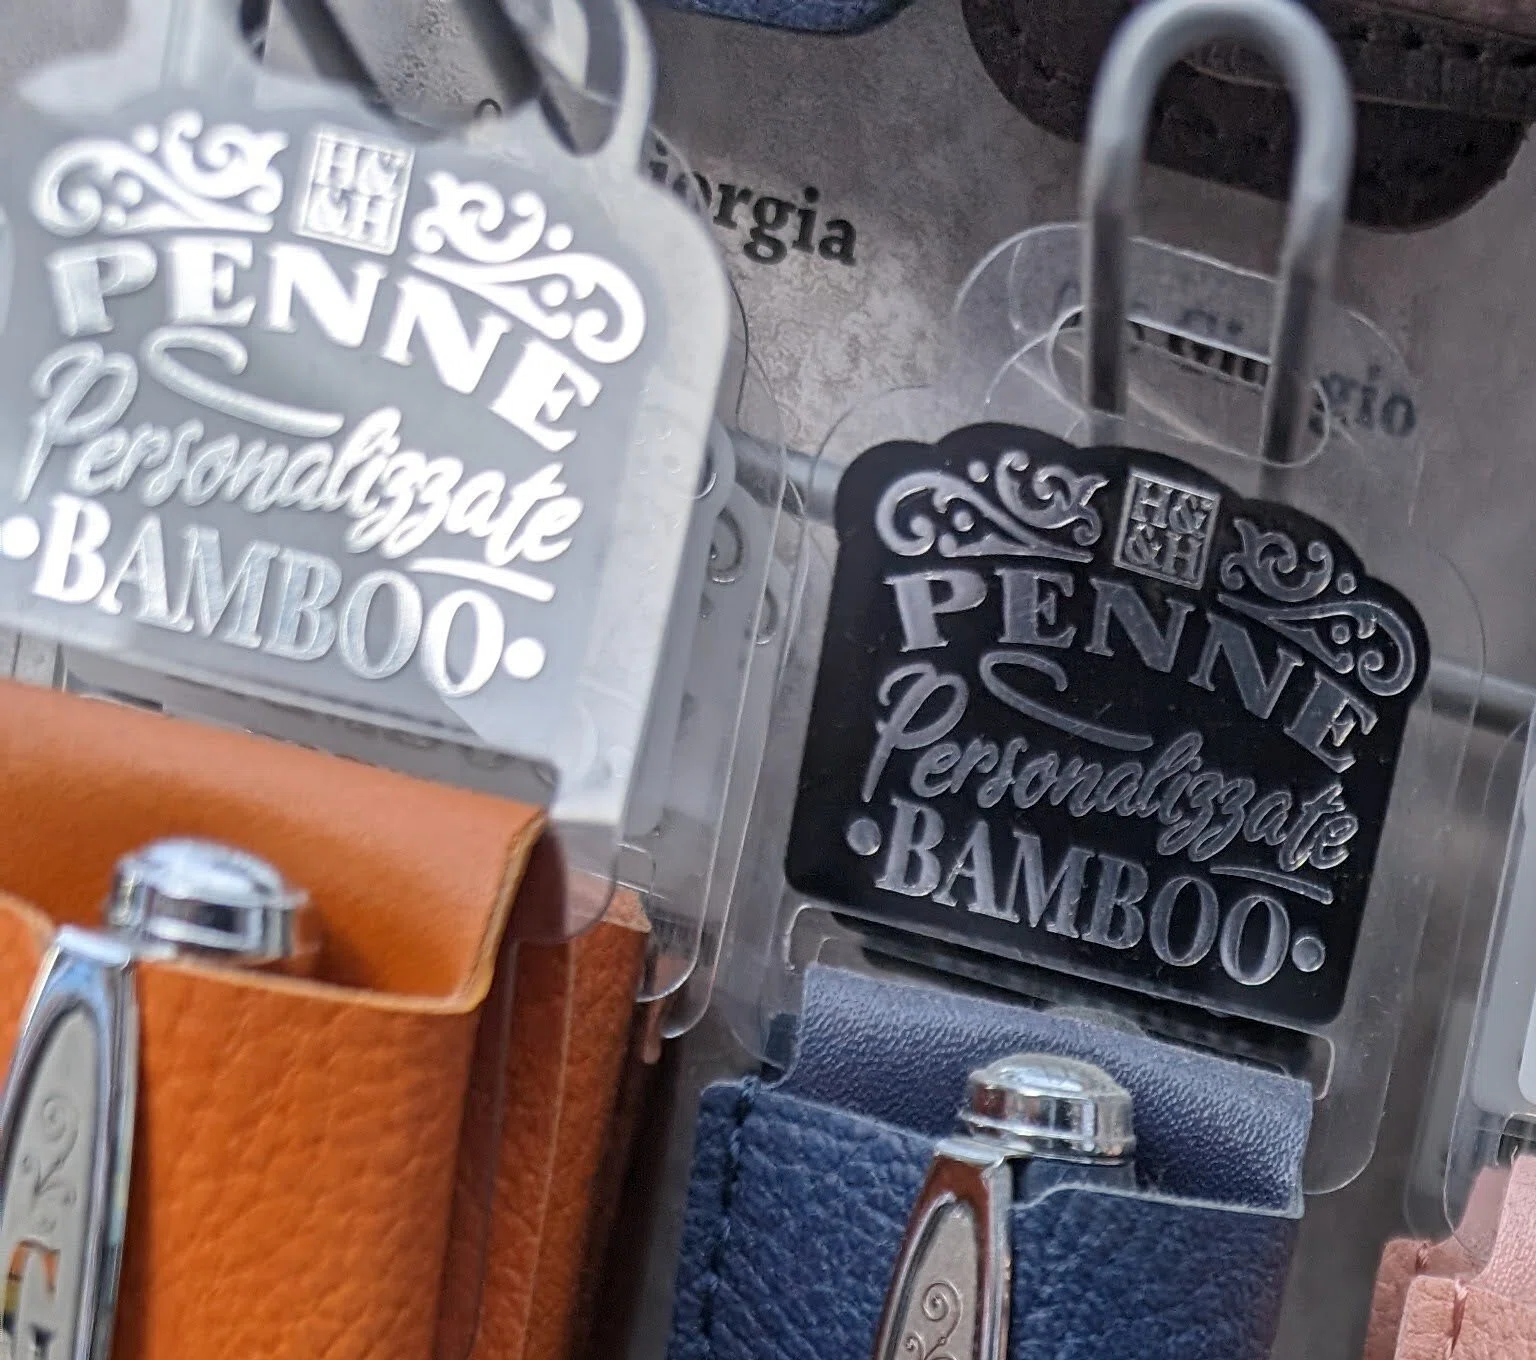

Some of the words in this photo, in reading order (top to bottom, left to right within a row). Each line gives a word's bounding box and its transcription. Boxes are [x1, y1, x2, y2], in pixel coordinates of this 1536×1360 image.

[20, 326, 584, 568] Personalizzate
[47, 236, 603, 453] PENNE
[31, 495, 504, 697] BAMBOO
[883, 566, 1379, 774] PENNE
[861, 651, 1359, 872] Personalizzate
[875, 798, 1291, 988] BAMBOO
